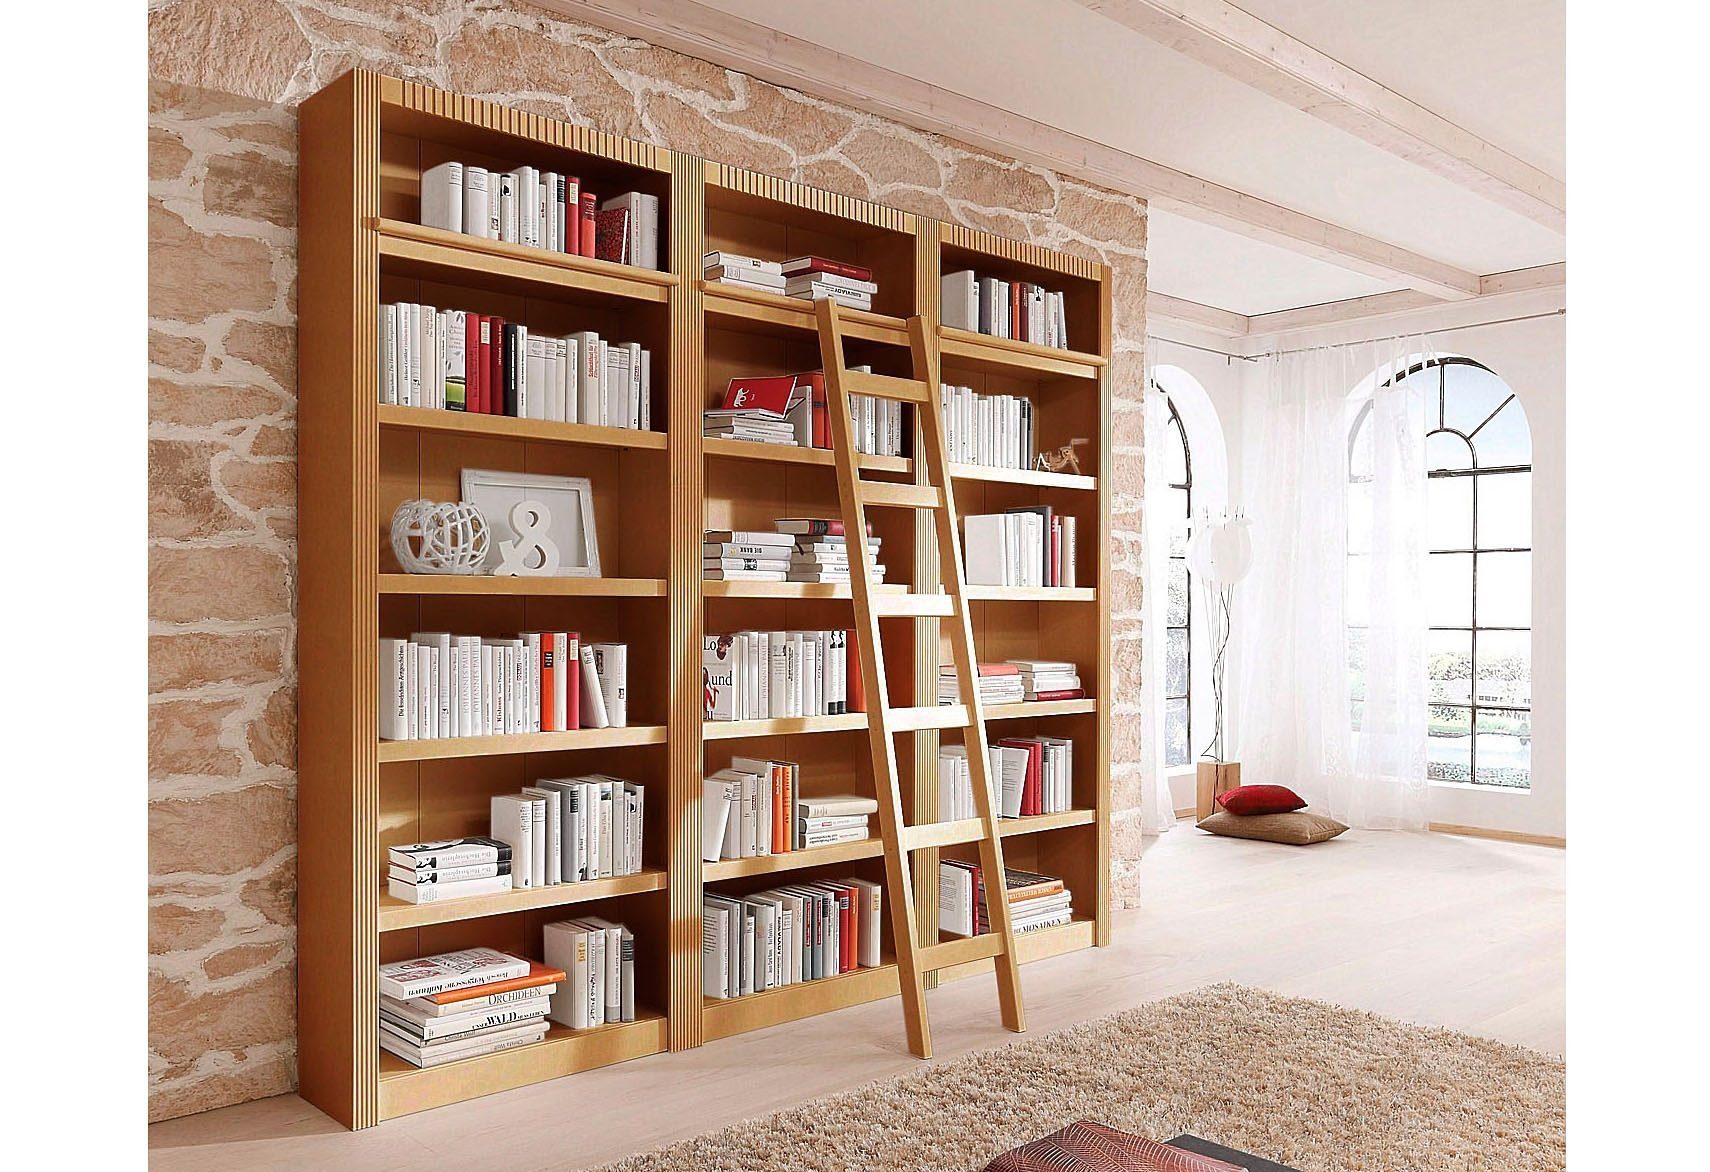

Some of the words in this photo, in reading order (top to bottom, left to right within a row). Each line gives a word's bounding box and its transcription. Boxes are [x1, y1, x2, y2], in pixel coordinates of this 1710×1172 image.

[704, 637, 716, 650] Lo
[712, 670, 732, 686] und
[1023, 918, 1061, 933] MOSAIKEN
[488, 987, 541, 1004] ORCHIDEEN
[487, 1012, 516, 1025] WALD
